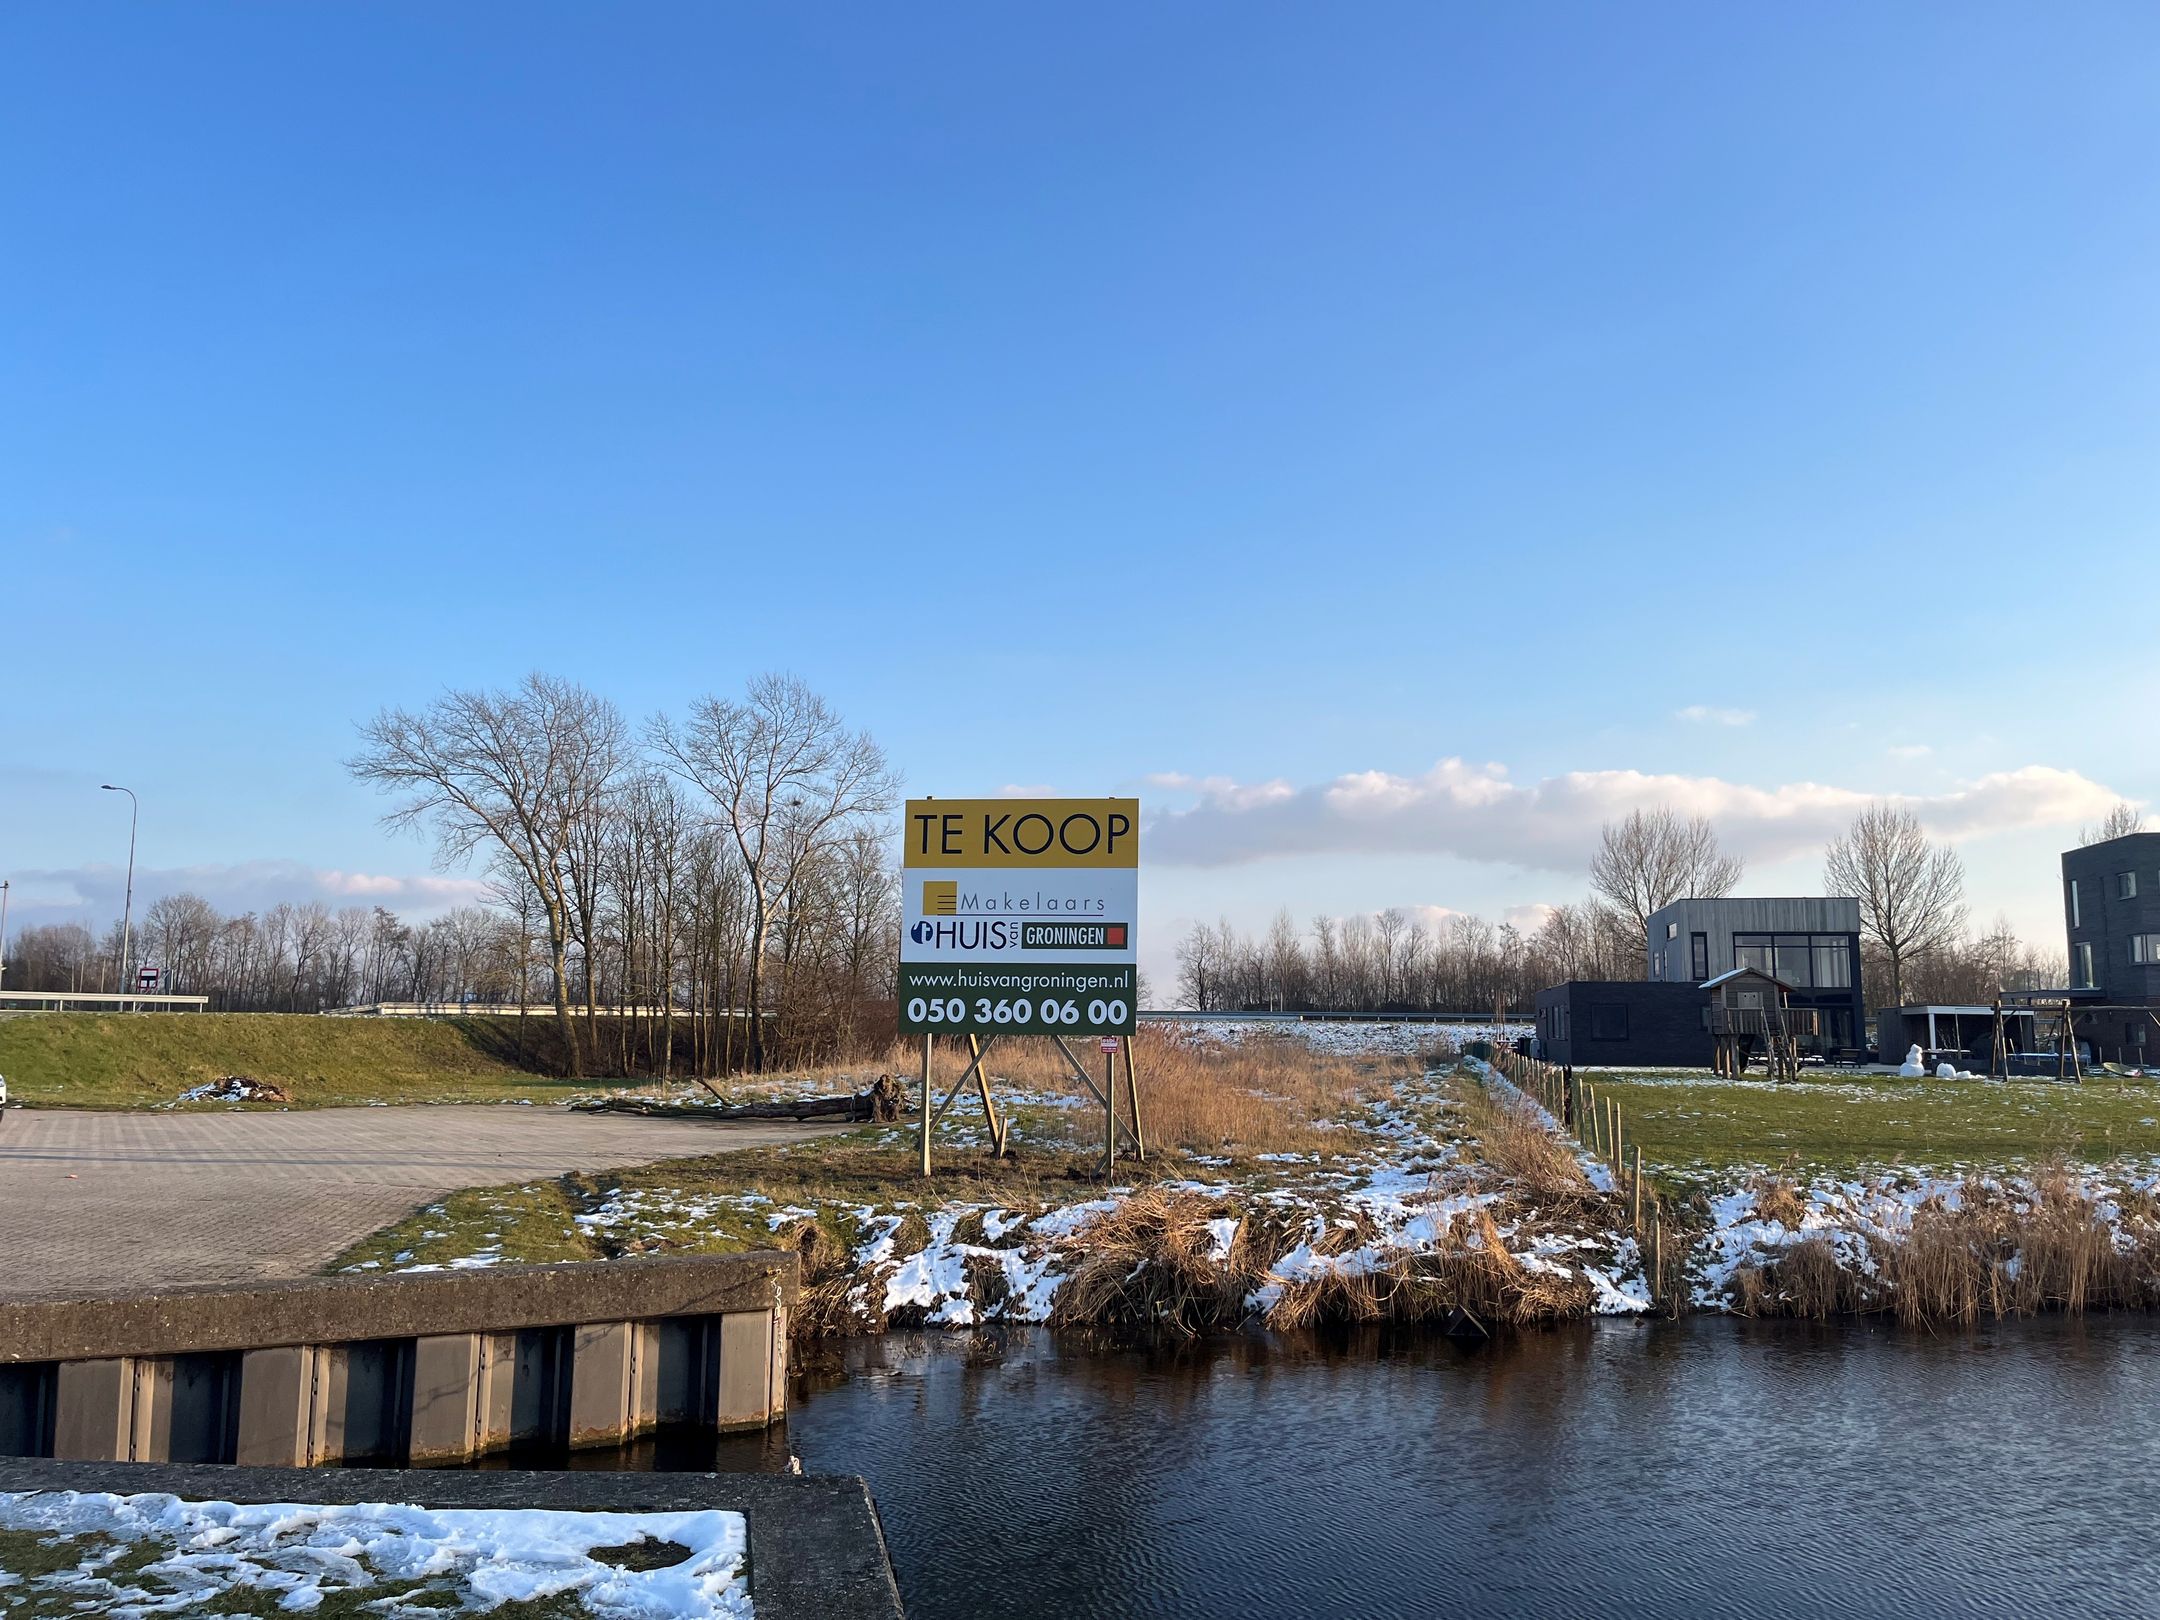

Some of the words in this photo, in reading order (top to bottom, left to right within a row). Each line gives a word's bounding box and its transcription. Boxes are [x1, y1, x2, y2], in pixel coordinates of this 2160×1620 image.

[914, 814, 963, 854] TE
[984, 813, 1130, 855] KOOP
[960, 892, 1105, 911] Makelaars
[936, 921, 1007, 950] HUIS
[1009, 922, 1019, 949] van
[1026, 927, 1104, 945] GRONINGEN
[909, 969, 1129, 993] www.huisvangroningen.nl
[907, 997, 966, 1023] 050
[973, 998, 1032, 1024] 360
[1040, 998, 1080, 1025] 06
[1087, 999, 1128, 1025] 00
